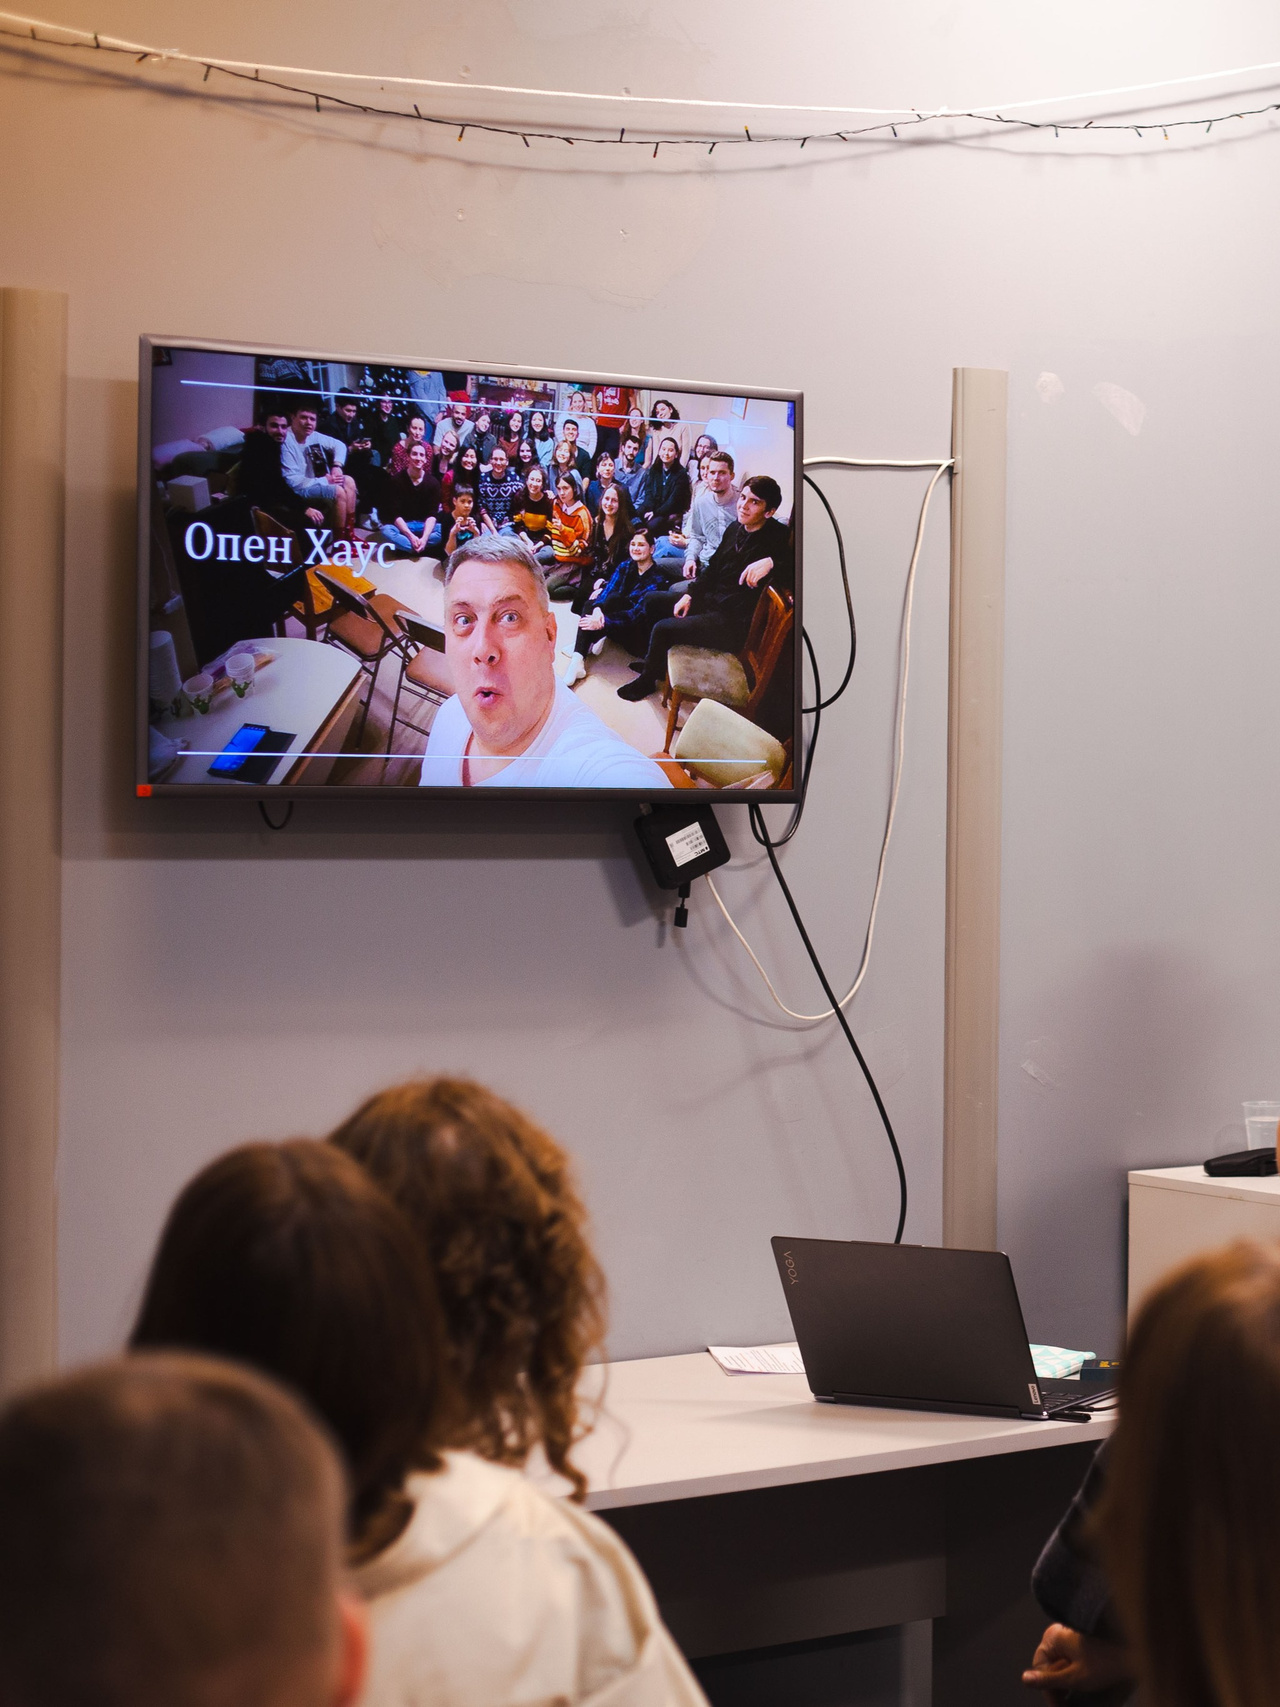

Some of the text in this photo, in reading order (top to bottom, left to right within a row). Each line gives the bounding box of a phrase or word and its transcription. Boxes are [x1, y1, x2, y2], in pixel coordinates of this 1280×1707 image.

[184, 521, 396, 578] Опен Хаус
[783, 1250, 799, 1285] YOGA
[1031, 1385, 1039, 1404] Lenovo
